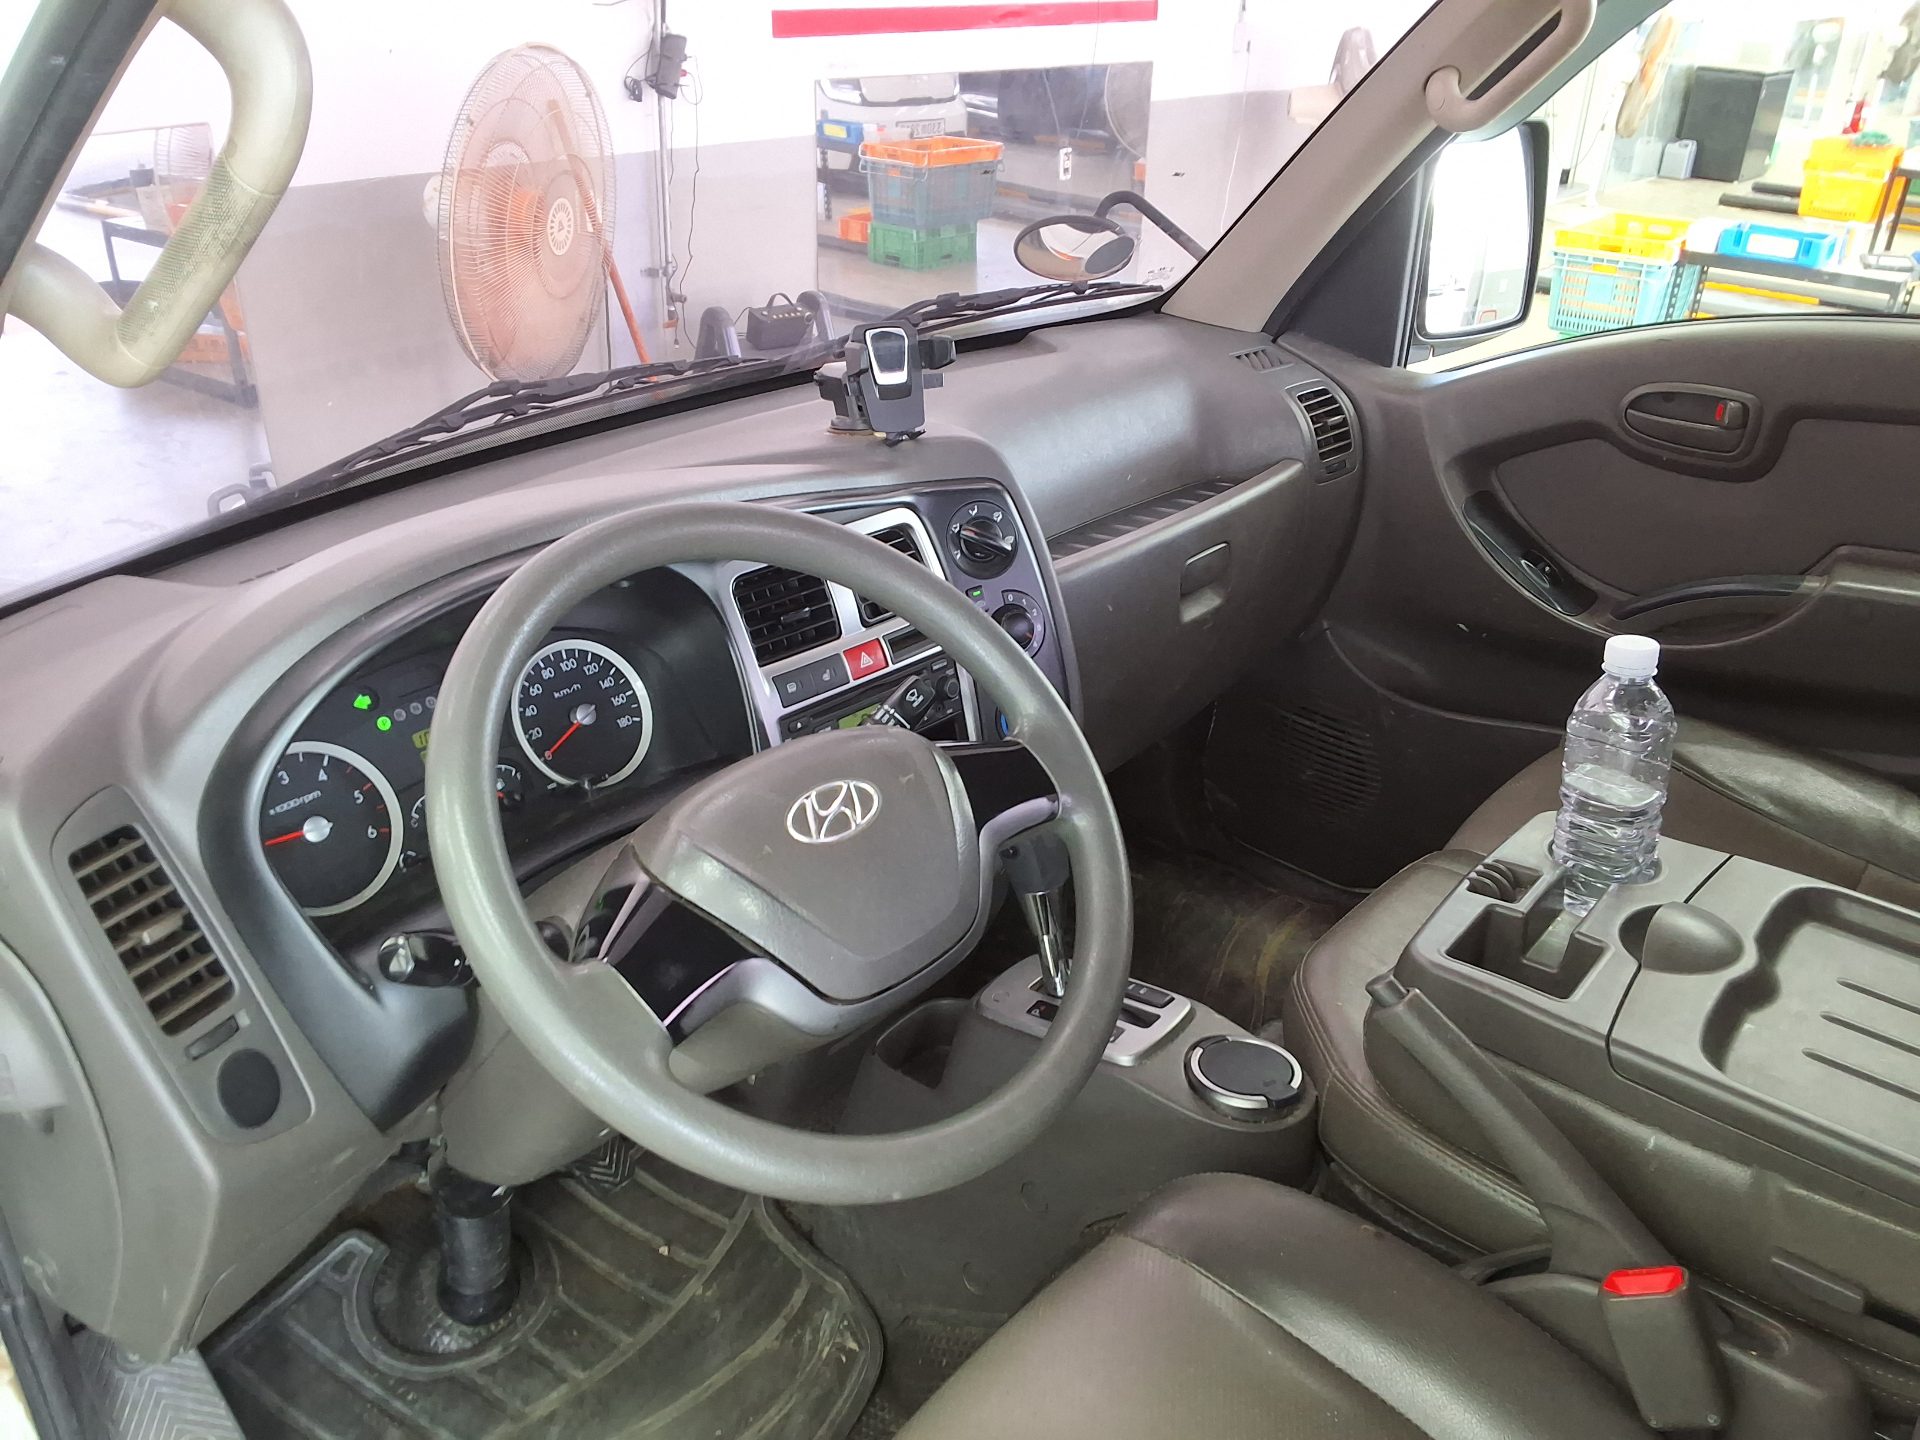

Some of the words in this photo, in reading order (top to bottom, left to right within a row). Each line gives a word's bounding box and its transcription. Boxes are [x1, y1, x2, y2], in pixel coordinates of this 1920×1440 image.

[1007, 594, 1014, 602] 0
[560, 658, 578, 672] 100
[583, 662, 599, 676] 120
[541, 667, 555, 680] 80
[599, 676, 615, 689] 140
[529, 683, 543, 696] 60
[553, 683, 581, 699] km/h
[611, 693, 627, 707] 160
[525, 704, 538, 717] 40
[616, 715, 633, 728] 180
[528, 727, 543, 740] 20
[277, 770, 290, 785] 3
[318, 768, 328, 781] 4
[353, 789, 364, 804] 5
[367, 825, 378, 839] 6
